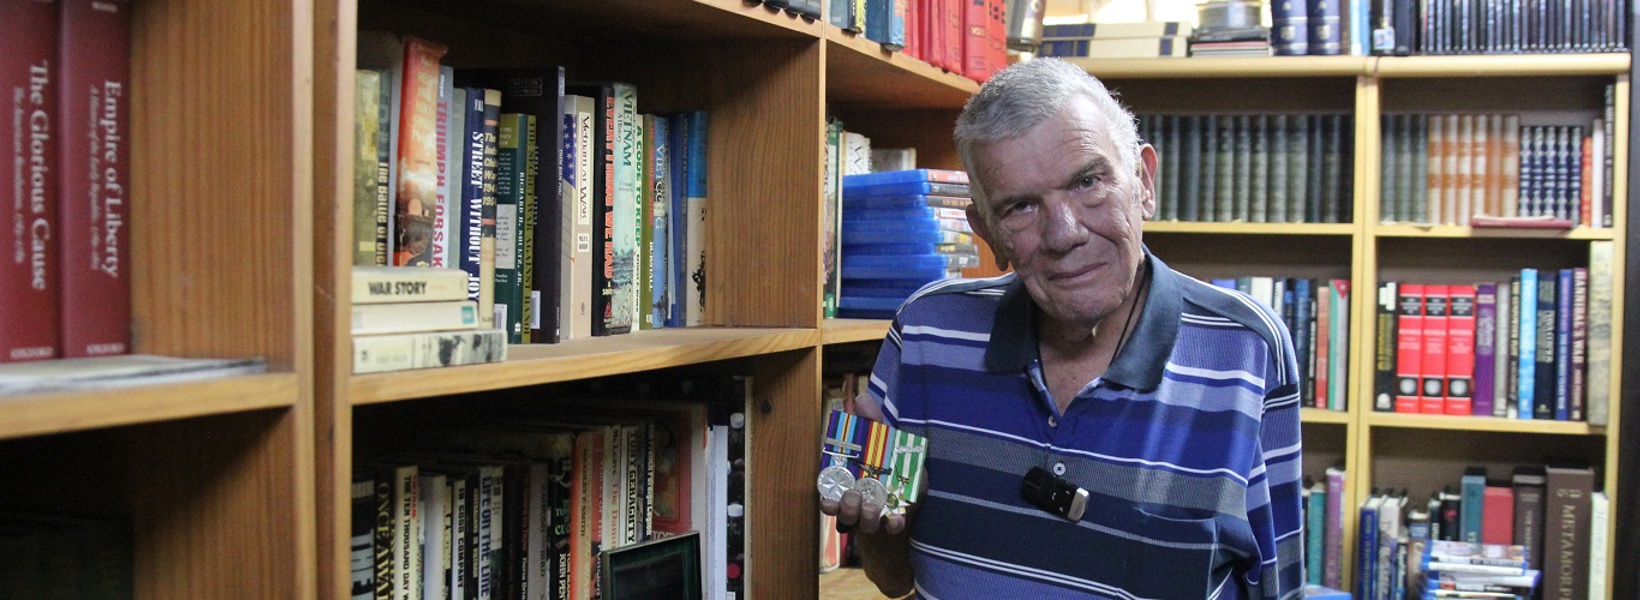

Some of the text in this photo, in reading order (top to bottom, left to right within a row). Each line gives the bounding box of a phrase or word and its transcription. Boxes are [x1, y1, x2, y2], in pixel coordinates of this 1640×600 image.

[436, 102, 448, 187] TRIUMPH
[623, 93, 633, 167] VIETNAM
[636, 125, 643, 137] A
[30, 59, 50, 290] The Glorious Cause
[99, 80, 123, 278] Empire of Liberty
[526, 152, 536, 197] SECRET
[603, 97, 615, 279] EVERYTHING WE HAD
[636, 187, 642, 205] TO
[467, 131, 484, 300] STREET WITHOUT JOY
[525, 202, 535, 231] WAR
[524, 238, 533, 289] AGAINST
[368, 281, 428, 295] WAR STORY
[376, 482, 390, 540] ONCE
[404, 498, 412, 516] TEN
[458, 488, 465, 500] IN
[482, 477, 491, 507] LIFE
[611, 481, 619, 506] The
[628, 470, 637, 542] GERAGHTY
[403, 519, 411, 569] THOUSAND
[457, 538, 465, 589] COMPANY
[481, 533, 491, 561] THE
[558, 552, 567, 578] JOHN
[403, 573, 411, 590] DAY
